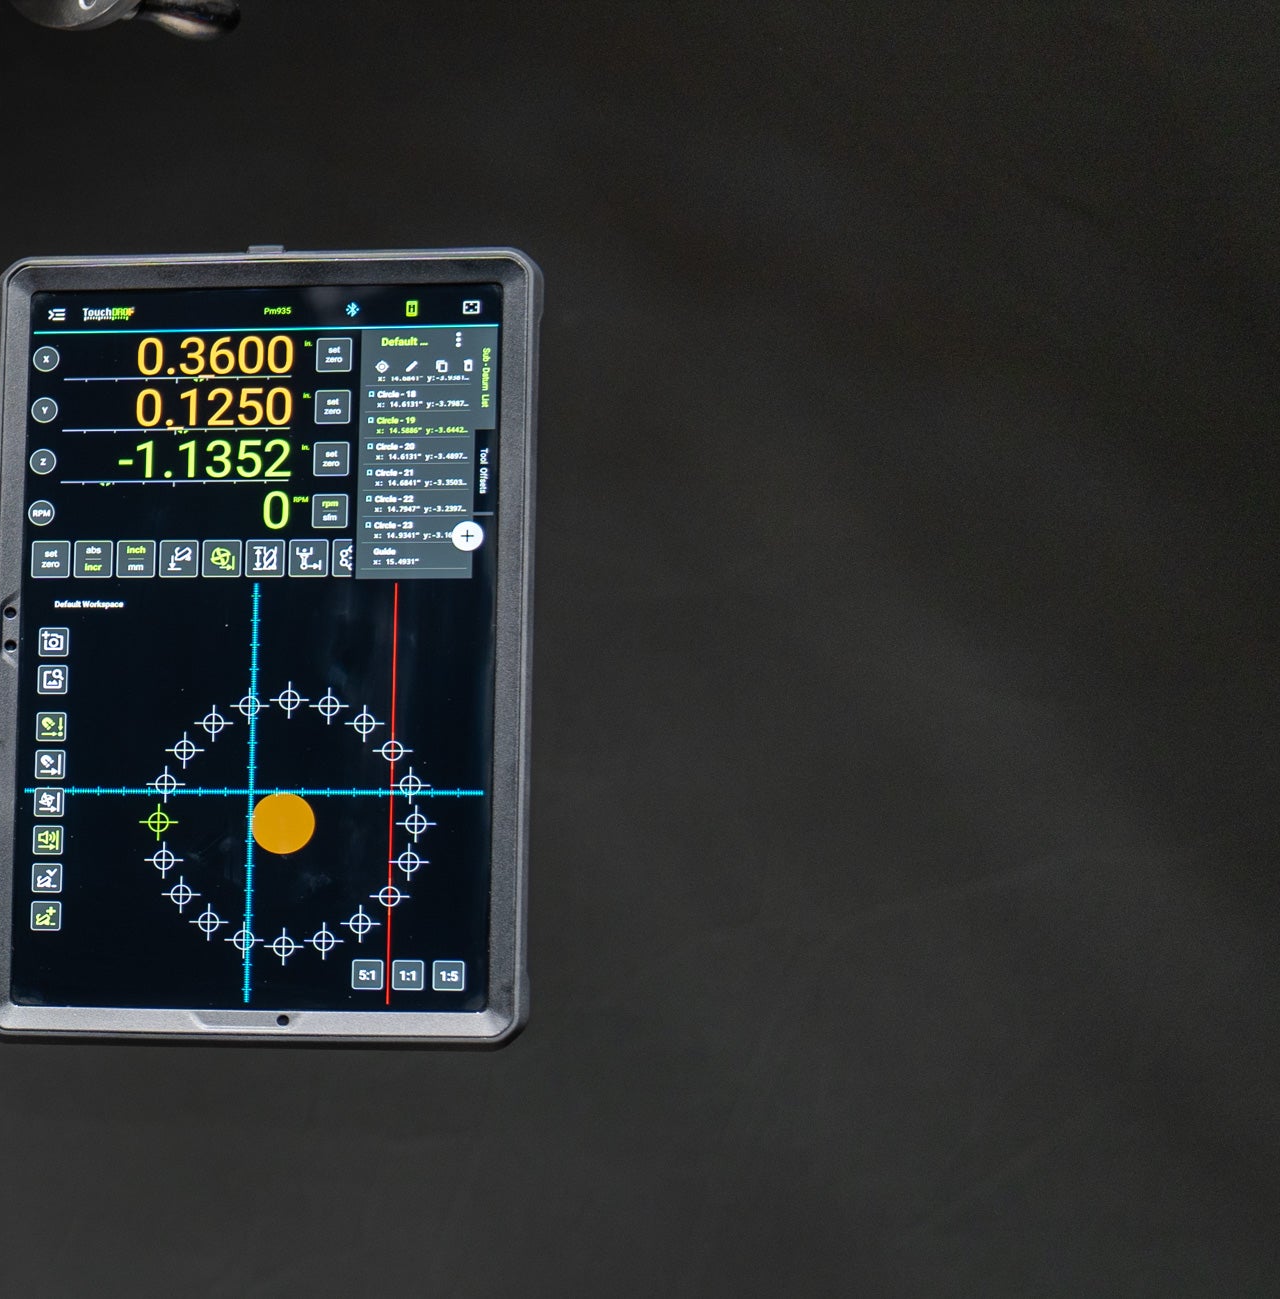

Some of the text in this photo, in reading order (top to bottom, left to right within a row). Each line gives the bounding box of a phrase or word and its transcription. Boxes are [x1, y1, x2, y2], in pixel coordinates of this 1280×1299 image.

[263, 307, 291, 315] Pm935
[381, 337, 418, 347] Default
[328, 346, 341, 354] set
[43, 355, 50, 363] X
[137, 335, 294, 376] 0.3600
[406, 390, 416, 398] 18
[481, 394, 489, 407] List
[41, 406, 48, 414] Y
[136, 387, 292, 427] 0.1250
[376, 443, 398, 451] Circle
[40, 458, 47, 466] Z
[118, 438, 292, 478] -1.1352
[479, 448, 488, 494] Tool Offsets
[374, 495, 397, 503] Circle
[403, 495, 414, 503] 22
[32, 509, 51, 517] RPM
[263, 490, 289, 530] 0
[86, 546, 102, 554] abs
[127, 545, 146, 554] inch
[373, 548, 396, 556] Guide
[44, 550, 58, 558] set
[84, 563, 102, 571] incr
[54, 600, 124, 610] Default Workspace
[358, 969, 376, 980] 5:1
[399, 970, 416, 981] 1:1
[439, 970, 459, 982] 1:5
